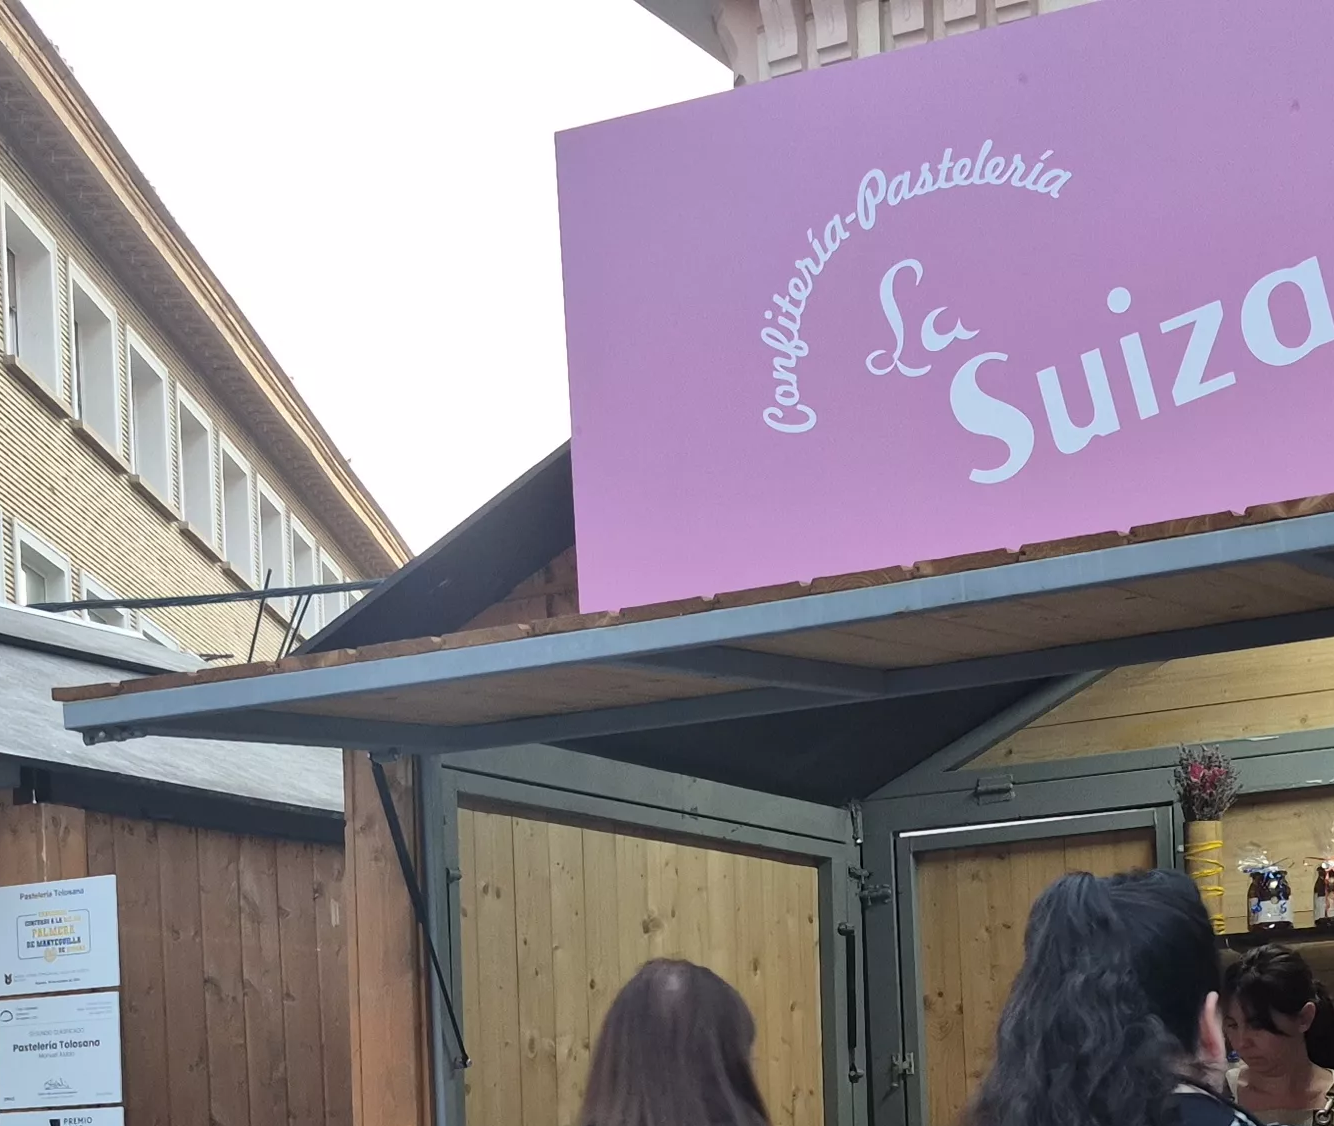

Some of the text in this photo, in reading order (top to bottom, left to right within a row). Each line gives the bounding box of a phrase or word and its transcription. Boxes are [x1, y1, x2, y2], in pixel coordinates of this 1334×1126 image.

[866, 258, 980, 377] La
[13, 1039, 100, 1052] Pastelería Tolosana
[63, 1117, 93, 1125] PREMIO
